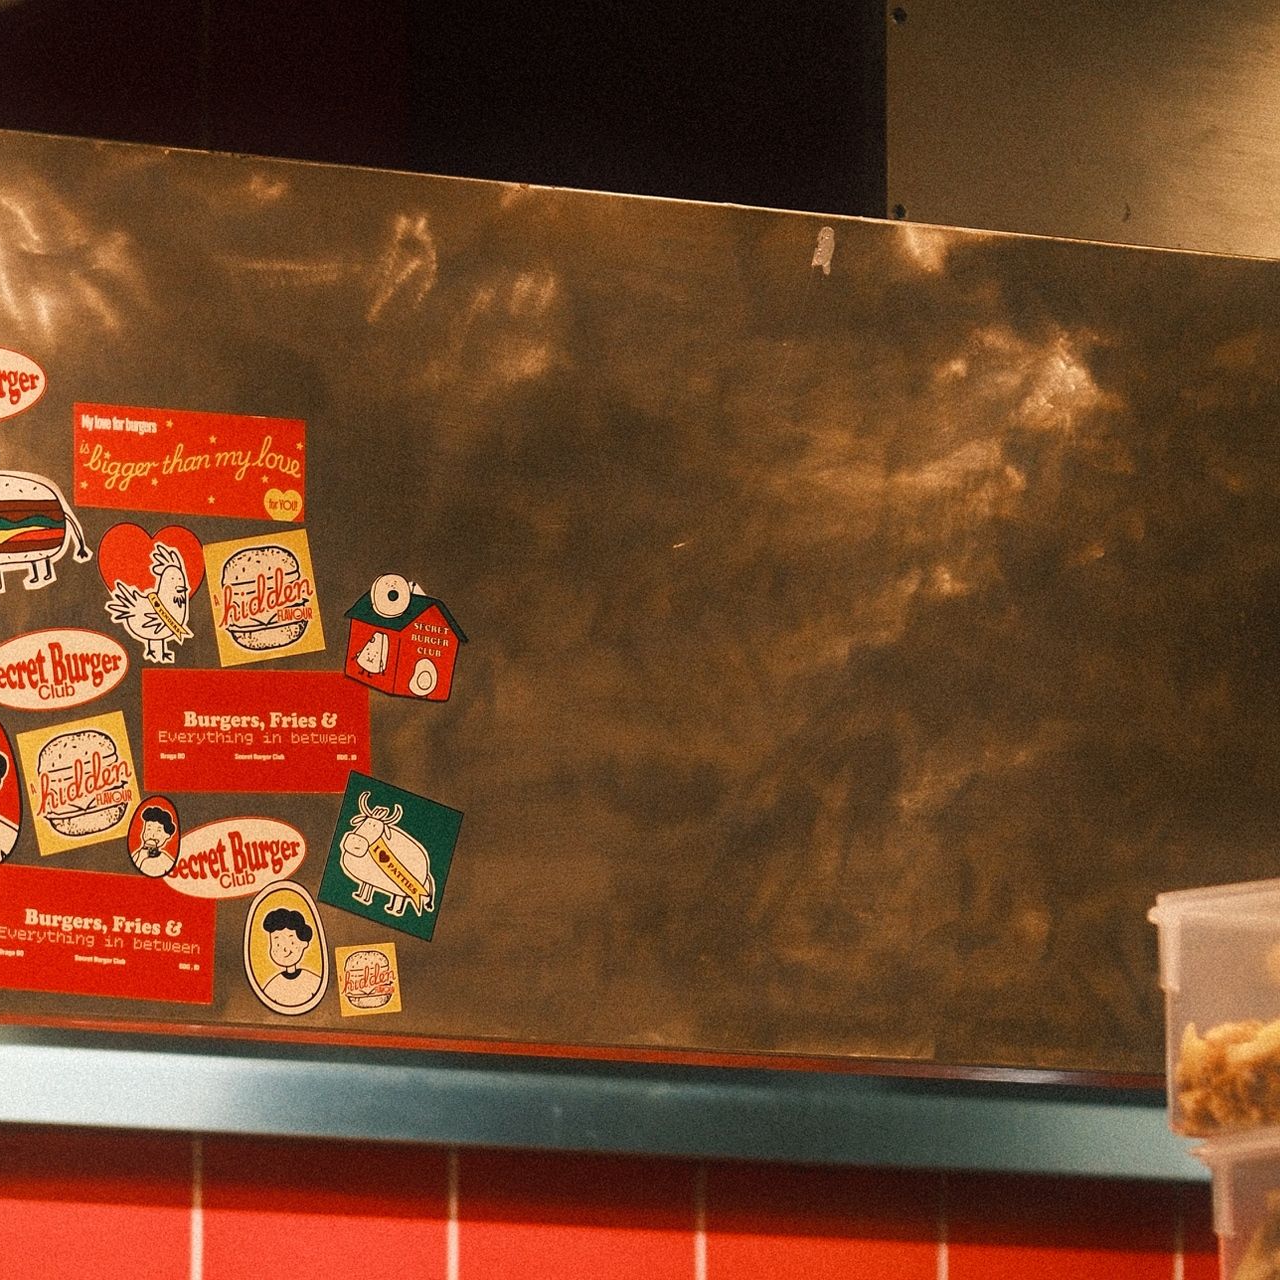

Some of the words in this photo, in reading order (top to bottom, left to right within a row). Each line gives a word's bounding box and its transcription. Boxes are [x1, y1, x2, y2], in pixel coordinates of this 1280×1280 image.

[81, 414, 93, 432] My
[94, 414, 112, 431] love
[112, 416, 125, 432] for
[126, 418, 157, 435] burgers
[80, 440, 90, 454] is
[162, 443, 211, 474] than
[251, 436, 301, 478] love
[84, 444, 159, 491] bigger
[215, 450, 251, 481] my
[219, 567, 314, 627] hidden
[157, 608, 181, 634] TENDERS
[277, 607, 313, 622] FLAVOUR
[414, 622, 449, 635] SECRET
[411, 634, 449, 647] BURGER
[416, 647, 441, 657] CLUB
[48, 642, 122, 687] Burger
[38, 682, 75, 700] Club
[184, 711, 265, 731] Burgers,
[270, 712, 317, 728] Fries
[321, 712, 338, 728] &
[158, 731, 253, 745] Everything
[263, 732, 281, 744] in
[291, 732, 356, 744] between
[37, 751, 132, 816] hidden
[95, 790, 132, 806] FLAVOUR
[228, 830, 300, 874] Burger
[220, 871, 256, 889] Club
[387, 863, 418, 895] PATTIES
[25, 908, 108, 933] Burgers,
[112, 915, 161, 936] Fries
[165, 920, 182, 936] &
[105, 934, 124, 948] in
[133, 937, 200, 954] between
[341, 963, 396, 994] hidden
